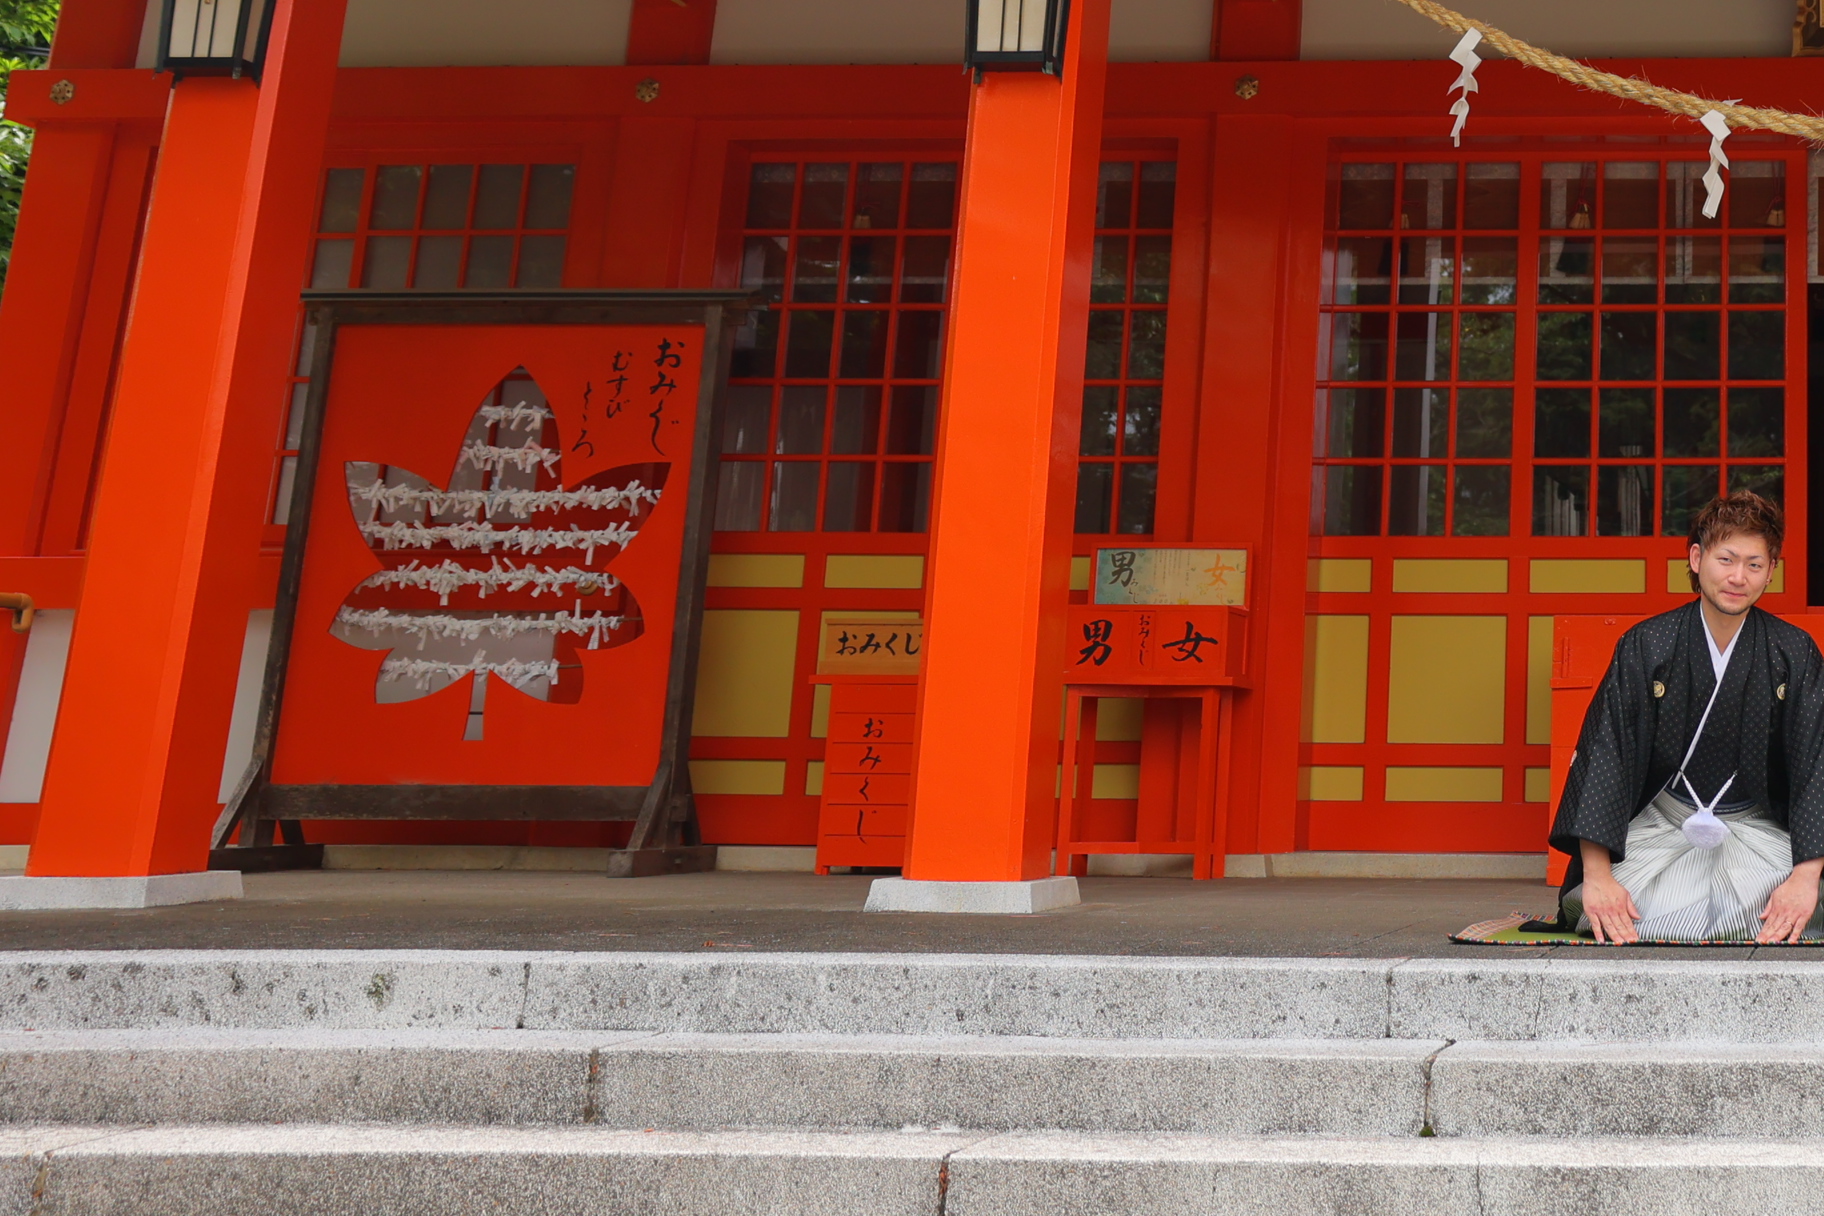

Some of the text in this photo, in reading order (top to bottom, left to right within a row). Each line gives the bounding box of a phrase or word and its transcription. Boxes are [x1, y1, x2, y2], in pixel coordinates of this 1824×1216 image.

[606, 350, 633, 419] むすび
[649, 337, 686, 457] おみくじ
[1108, 550, 1136, 588] 男
[1203, 553, 1237, 586] 女
[836, 630, 923, 656] おみくじ
[1075, 619, 1114, 666] 男
[1138, 614, 1151, 666] おみくじ
[1161, 621, 1219, 663] 女
[857, 717, 884, 844] おみくじ
